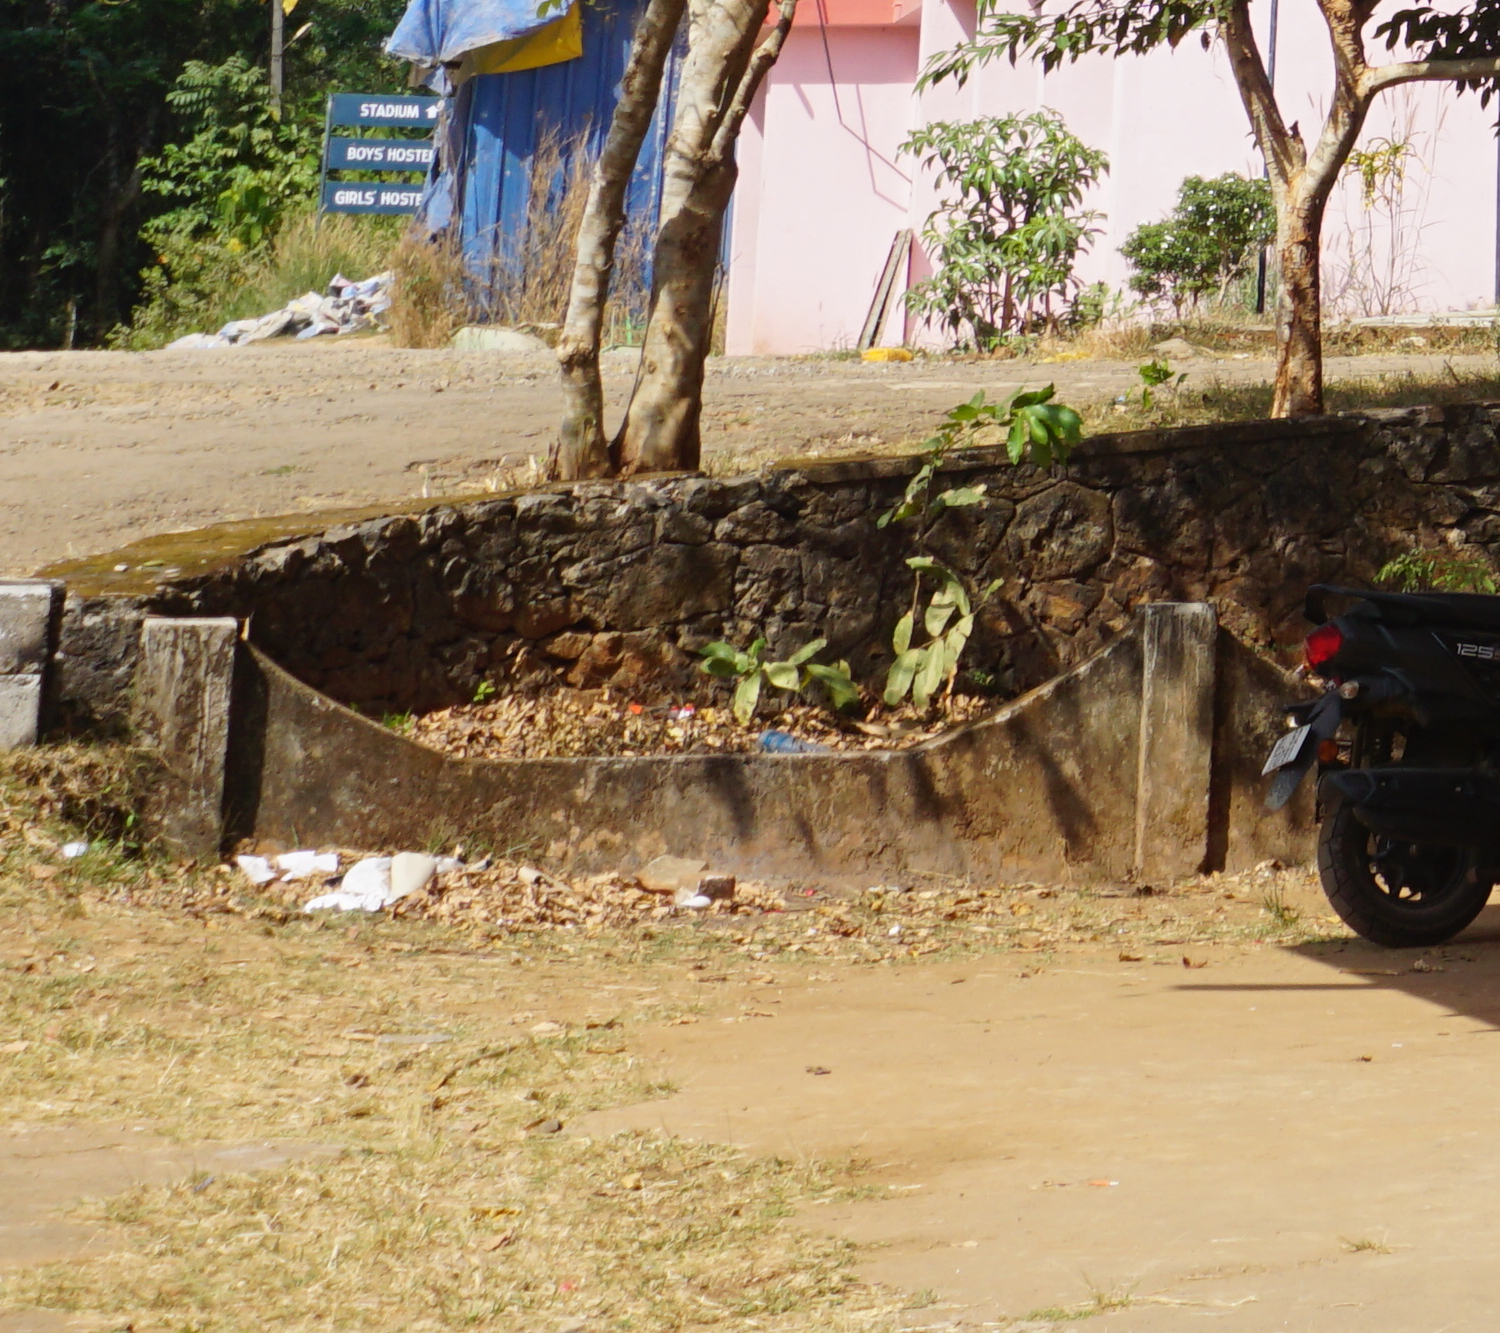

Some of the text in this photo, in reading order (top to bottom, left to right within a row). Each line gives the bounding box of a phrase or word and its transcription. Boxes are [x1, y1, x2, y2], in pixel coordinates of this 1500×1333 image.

[360, 103, 420, 119] STADIUM
[380, 191, 423, 207] HOSTE
[1456, 642, 1494, 659] 125
